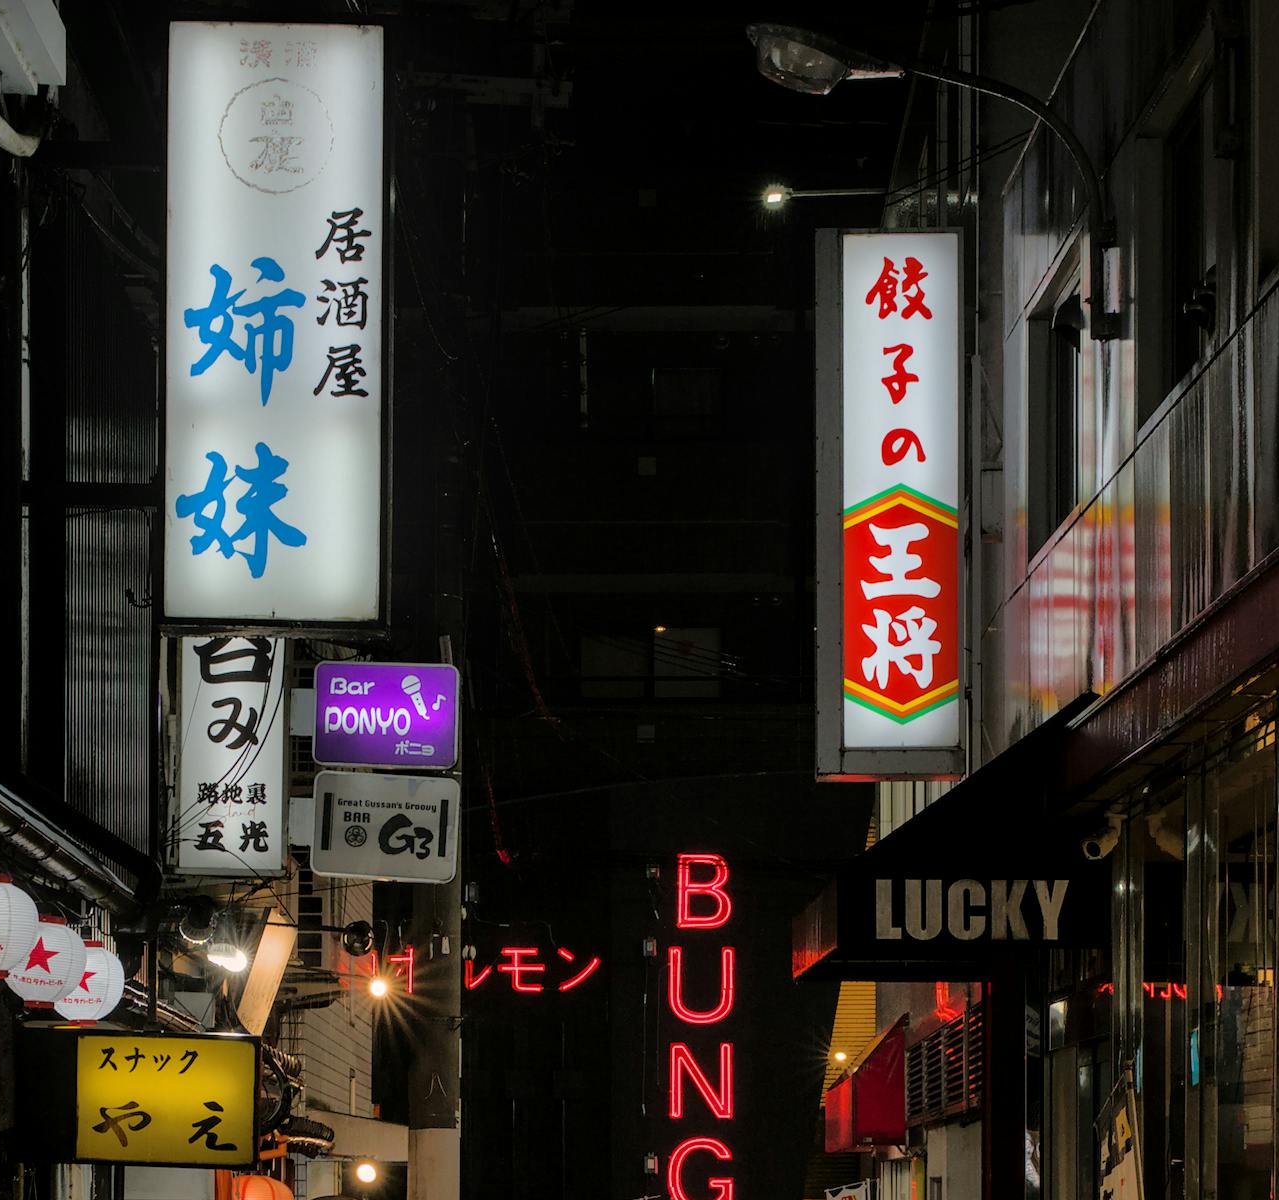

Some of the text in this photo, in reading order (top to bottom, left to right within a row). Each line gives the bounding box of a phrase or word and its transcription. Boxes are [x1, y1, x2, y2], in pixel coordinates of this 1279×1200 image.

[315, 207, 372, 398] 居酒屋
[176, 256, 307, 579] 姉妹
[860, 256, 942, 690] 餃子の王将
[329, 677, 375, 695] Bar
[324, 706, 411, 735] PONYO
[196, 781, 267, 805] 路地裏
[337, 797, 363, 808] Great
[344, 811, 371, 824] BAR
[194, 820, 269, 853] 五光
[378, 813, 434, 860] G3
[874, 879, 1070, 941] LUCKY
[98, 1046, 199, 1074] スナック
[91, 1101, 238, 1152] やえ
